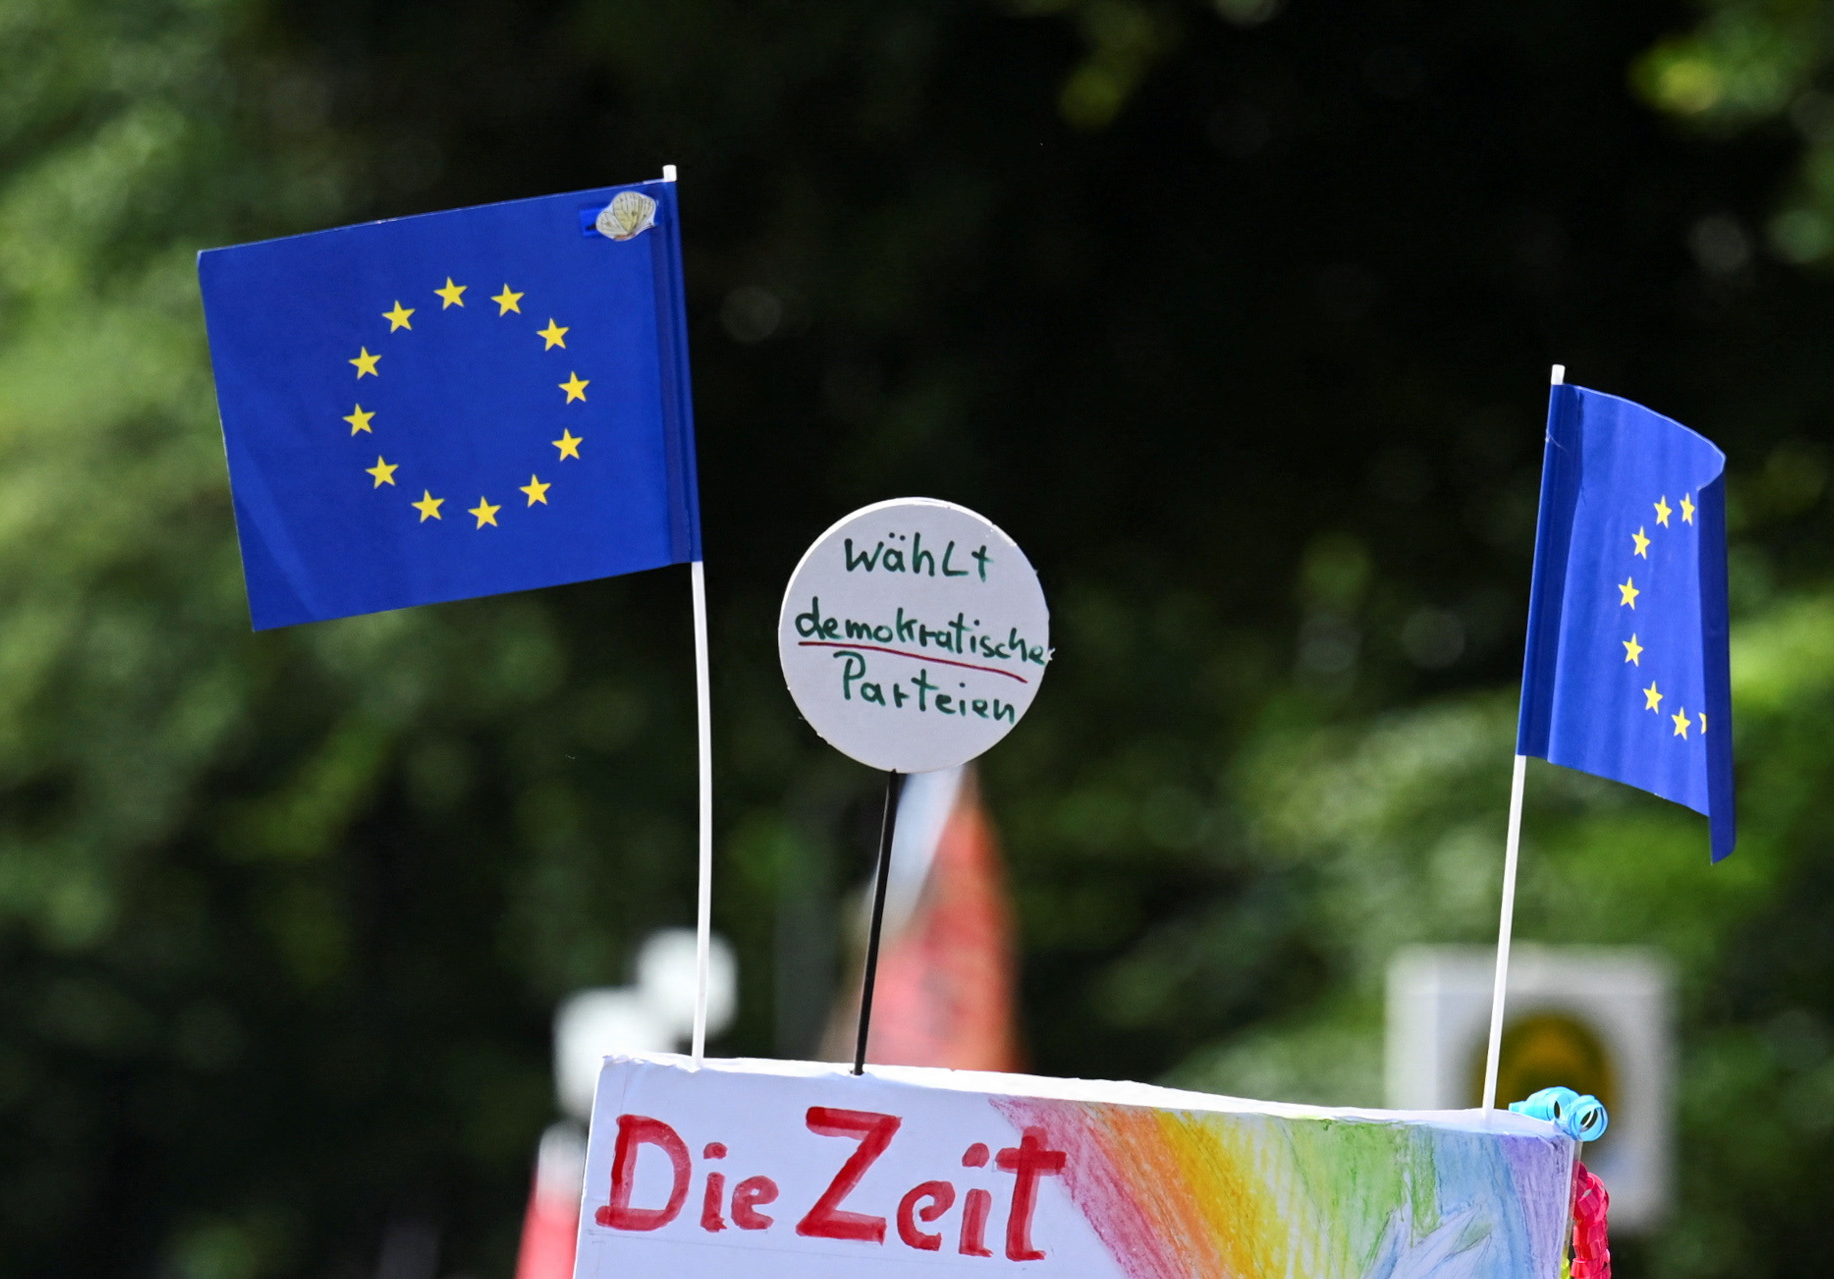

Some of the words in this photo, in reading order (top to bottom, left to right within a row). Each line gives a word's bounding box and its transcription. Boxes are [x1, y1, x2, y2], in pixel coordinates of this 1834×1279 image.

[795, 596, 1048, 666] demokratische
[833, 651, 1016, 724] Parteien
[594, 1113, 780, 1233] Die
[796, 1105, 1069, 1262] Zeit
